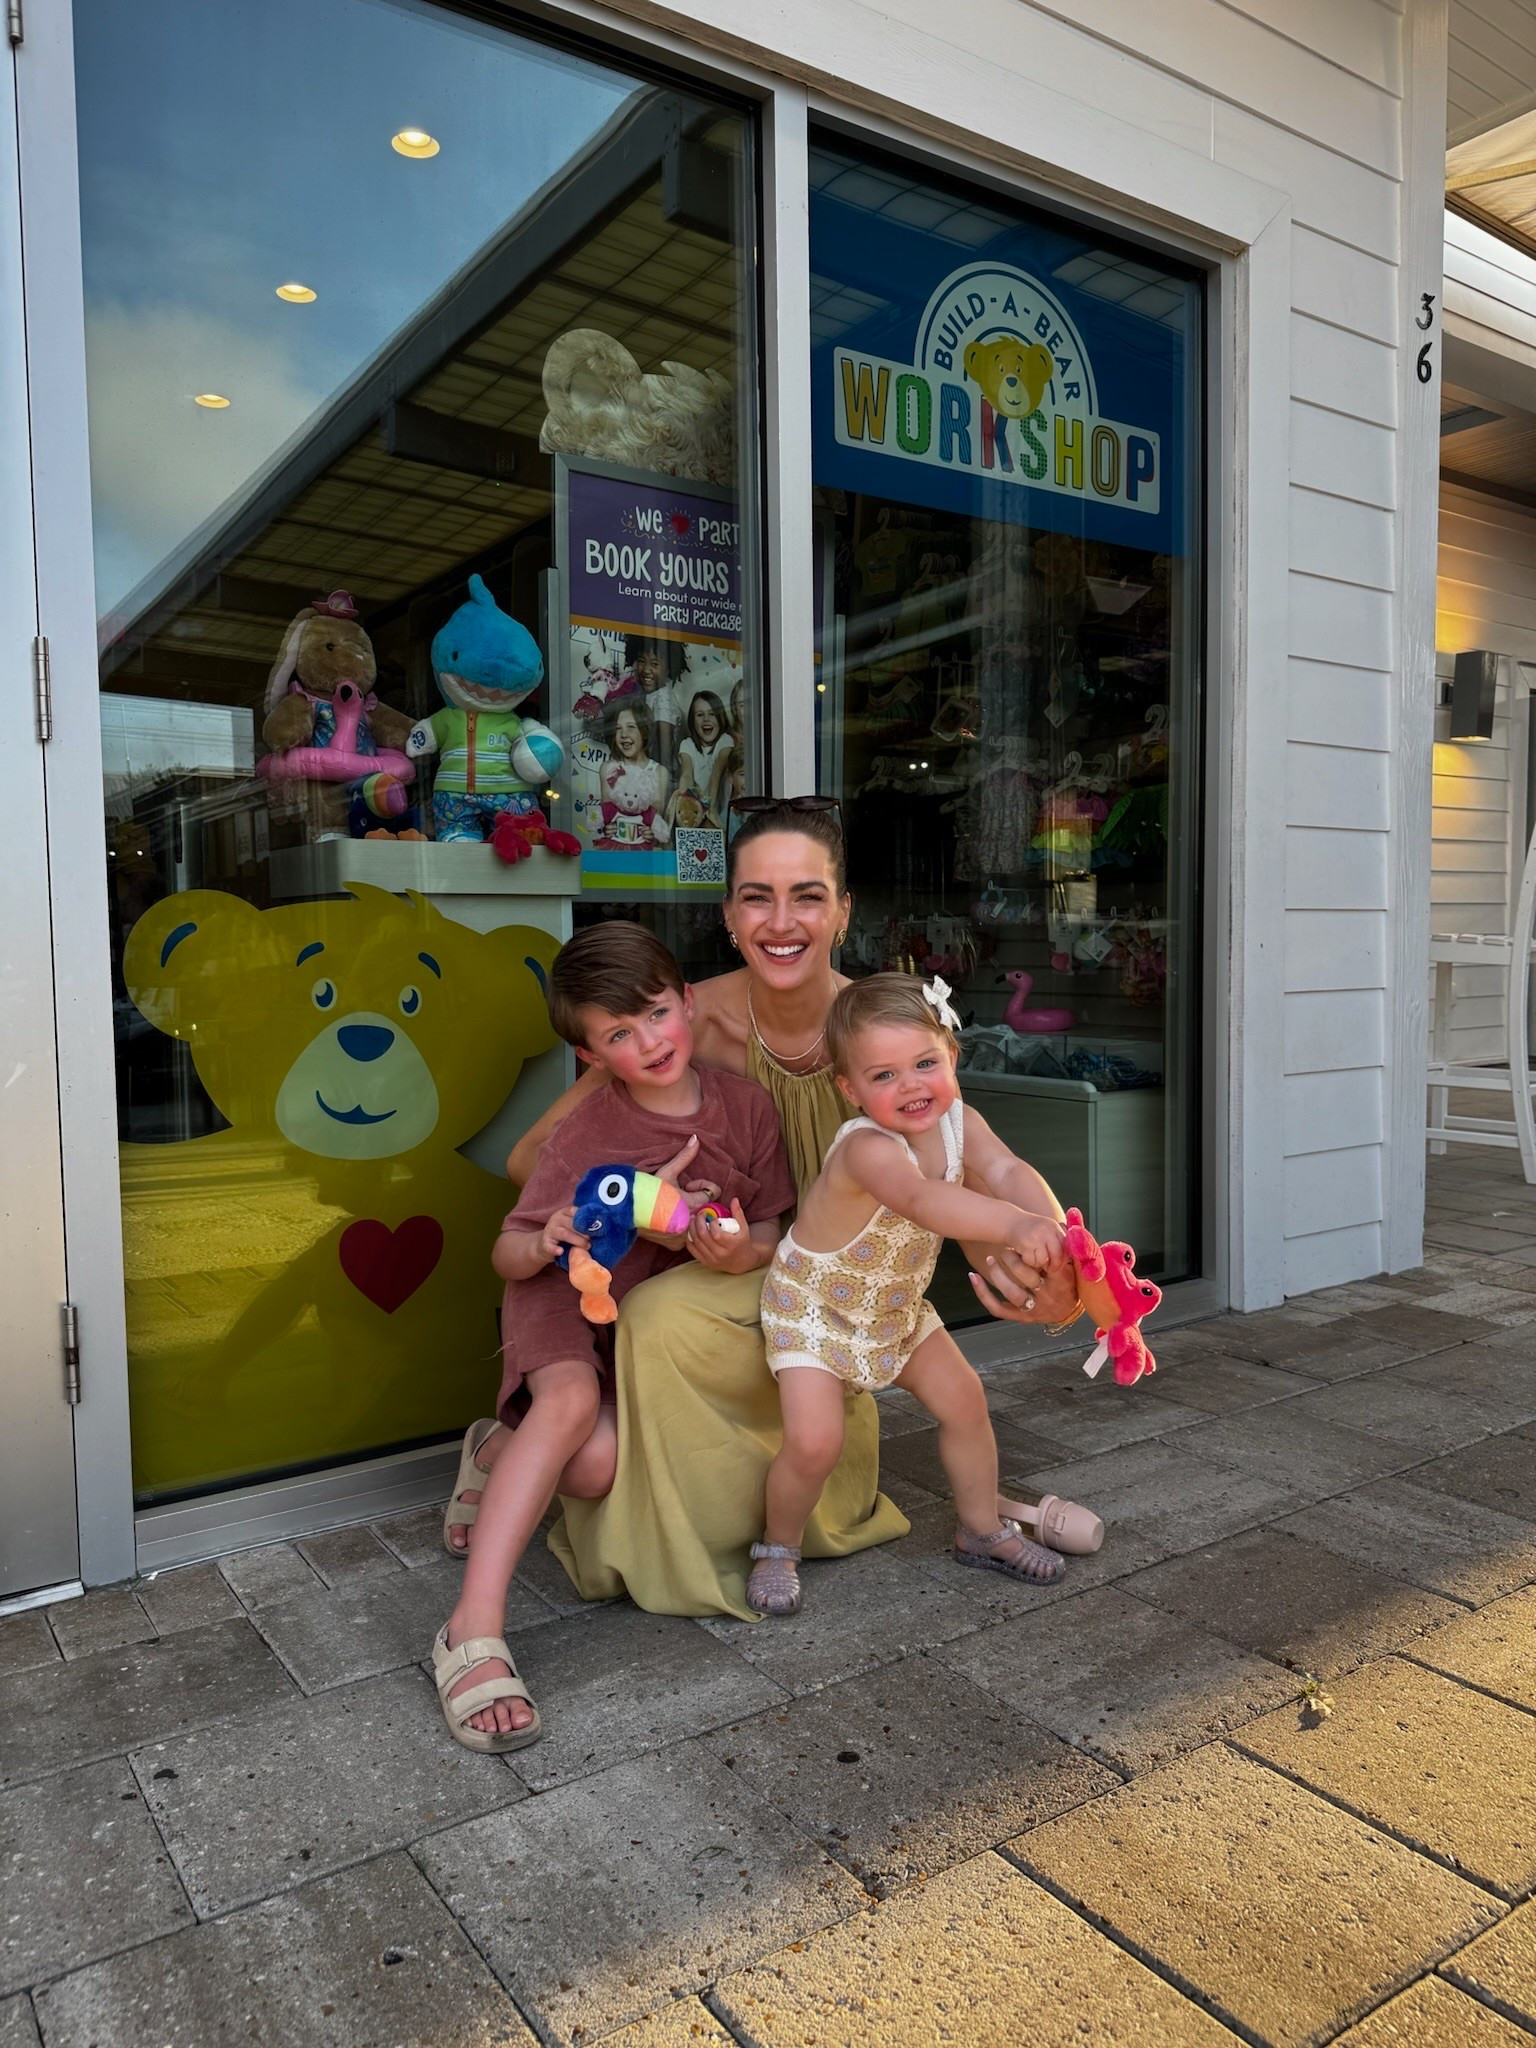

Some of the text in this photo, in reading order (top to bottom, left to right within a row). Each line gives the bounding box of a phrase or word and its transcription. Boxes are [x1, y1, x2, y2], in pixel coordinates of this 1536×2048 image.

[933, 290, 1082, 402] BUILD-A-BEAR
[840, 357, 1155, 503] WORKSHOP
[585, 538, 652, 583] BOOK
[618, 581, 652, 599] Learn
[654, 588, 689, 603] about
[690, 596, 709, 607] our
[710, 597, 737, 611] wide
